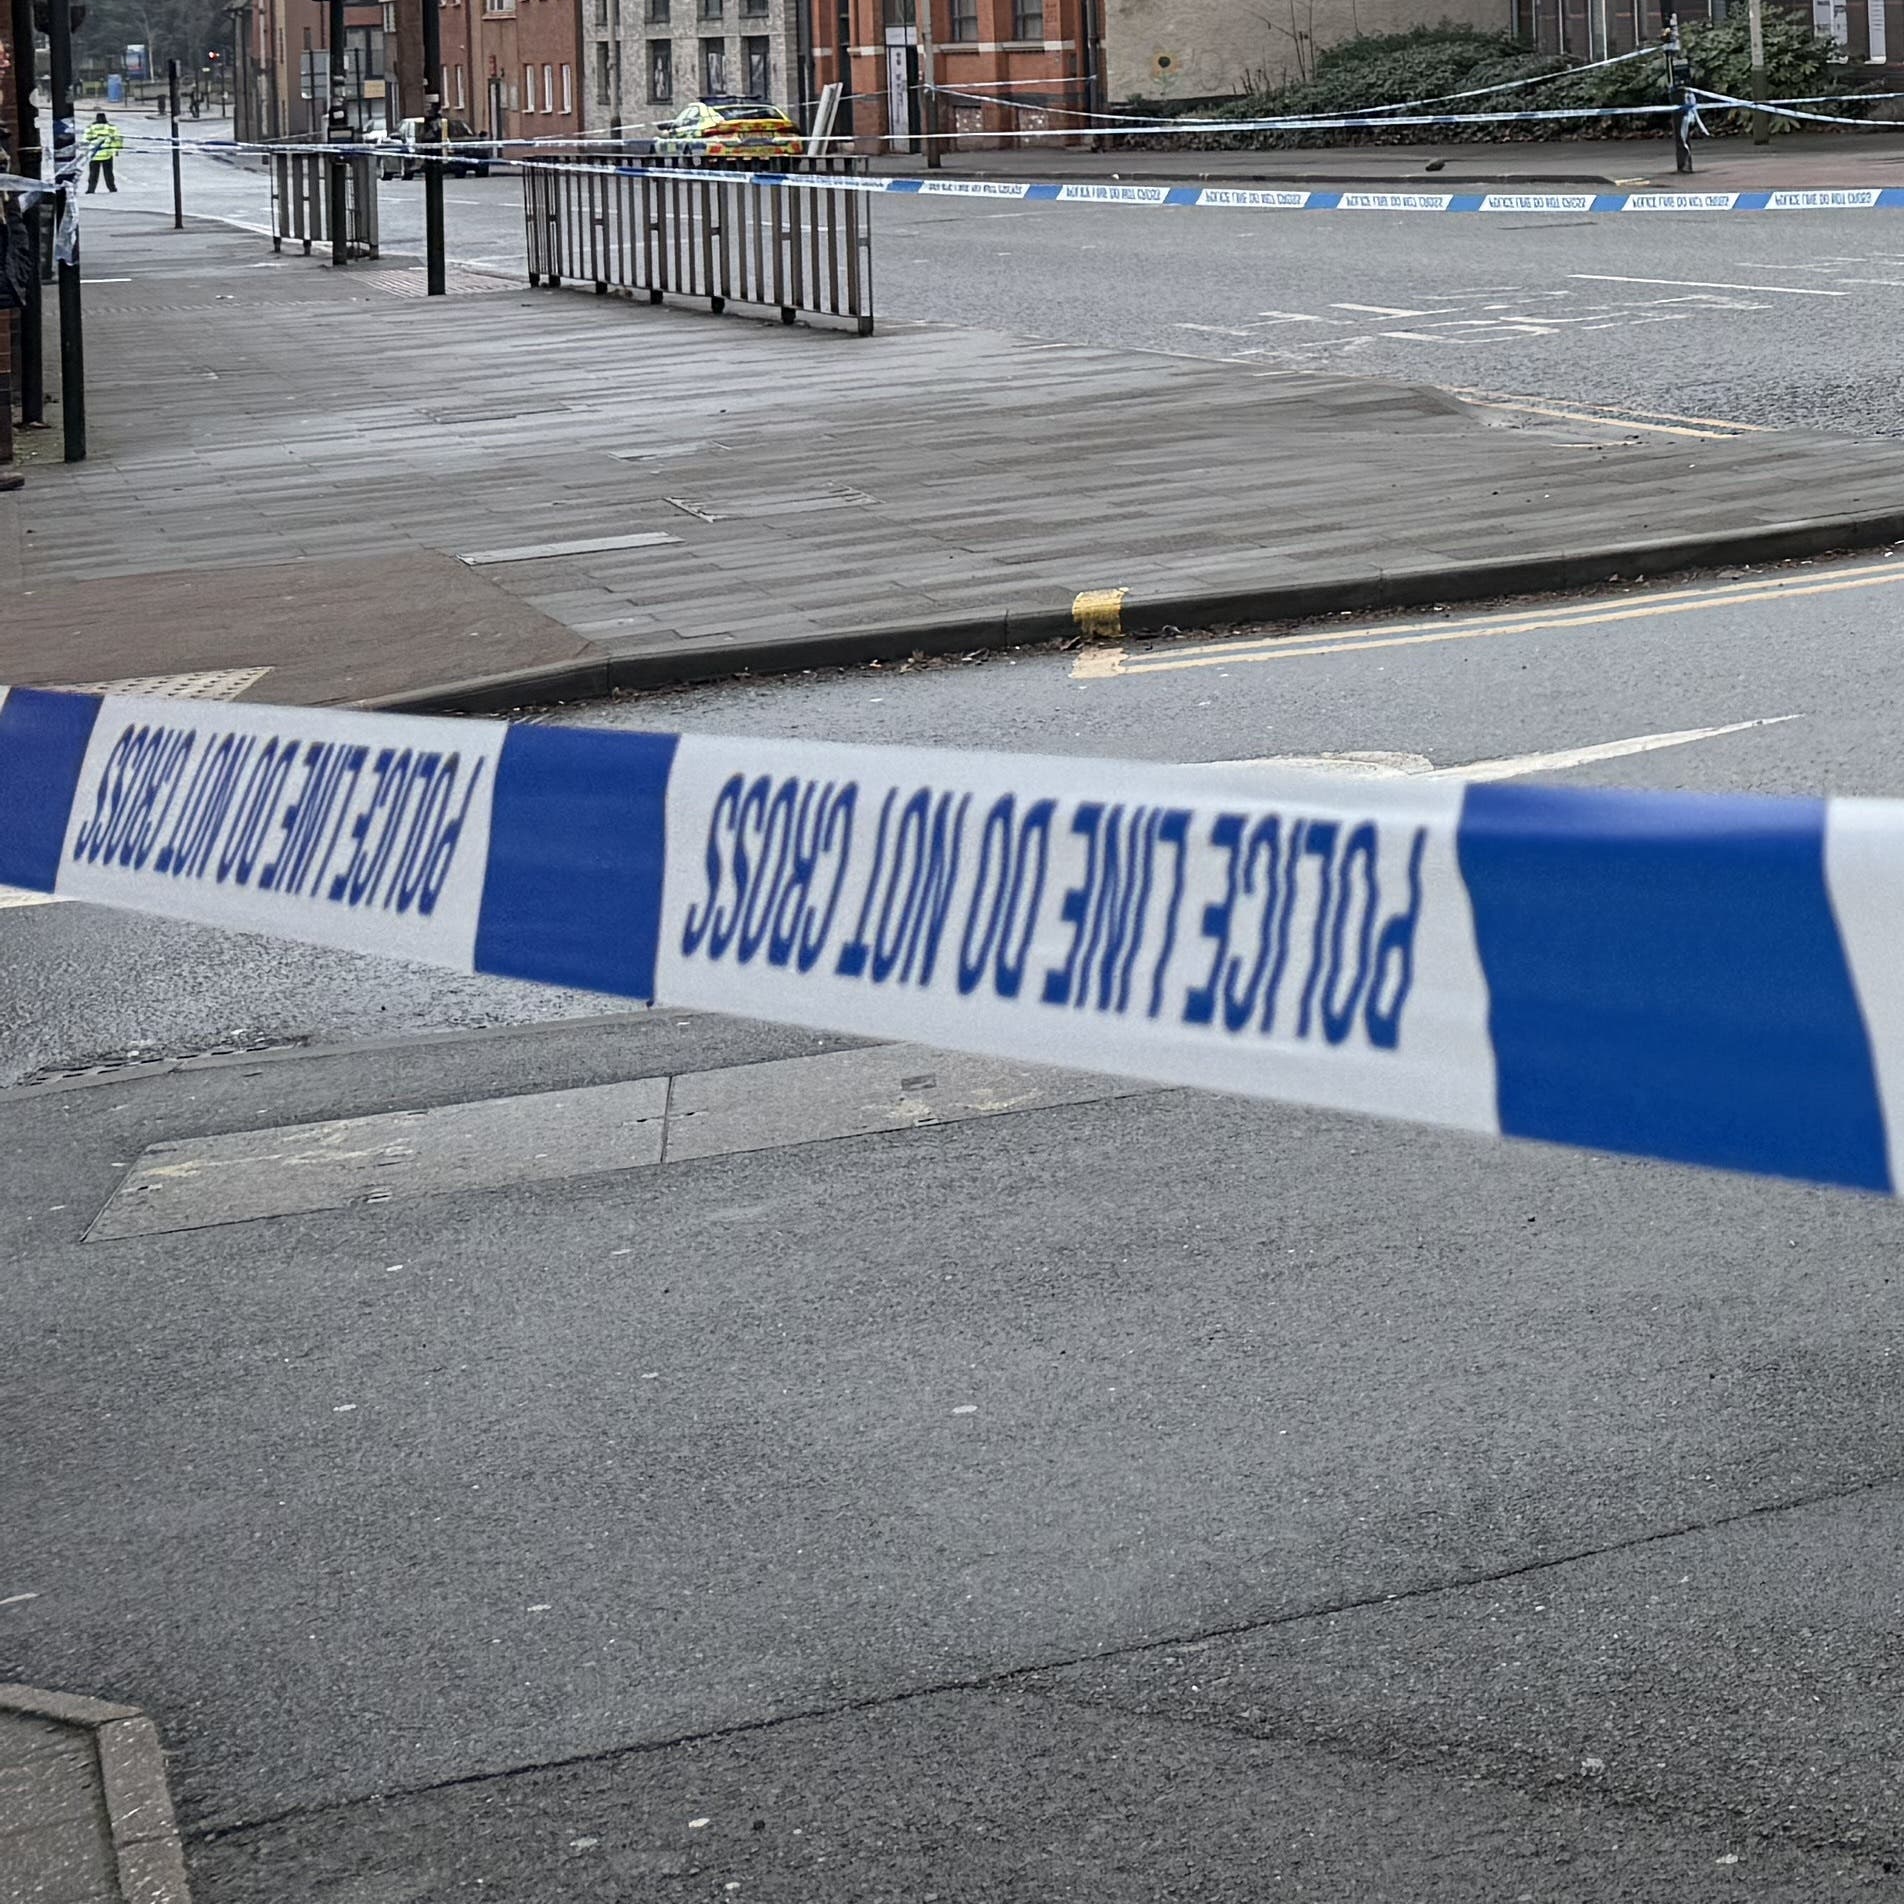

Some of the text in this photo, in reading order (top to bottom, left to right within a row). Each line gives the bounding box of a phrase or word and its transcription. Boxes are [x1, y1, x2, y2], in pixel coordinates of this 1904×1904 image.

[72, 723, 487, 917] POLICE LINE DO NOT CROSS
[681, 772, 1428, 1051] POLICE LINE DO NOT CROSS
